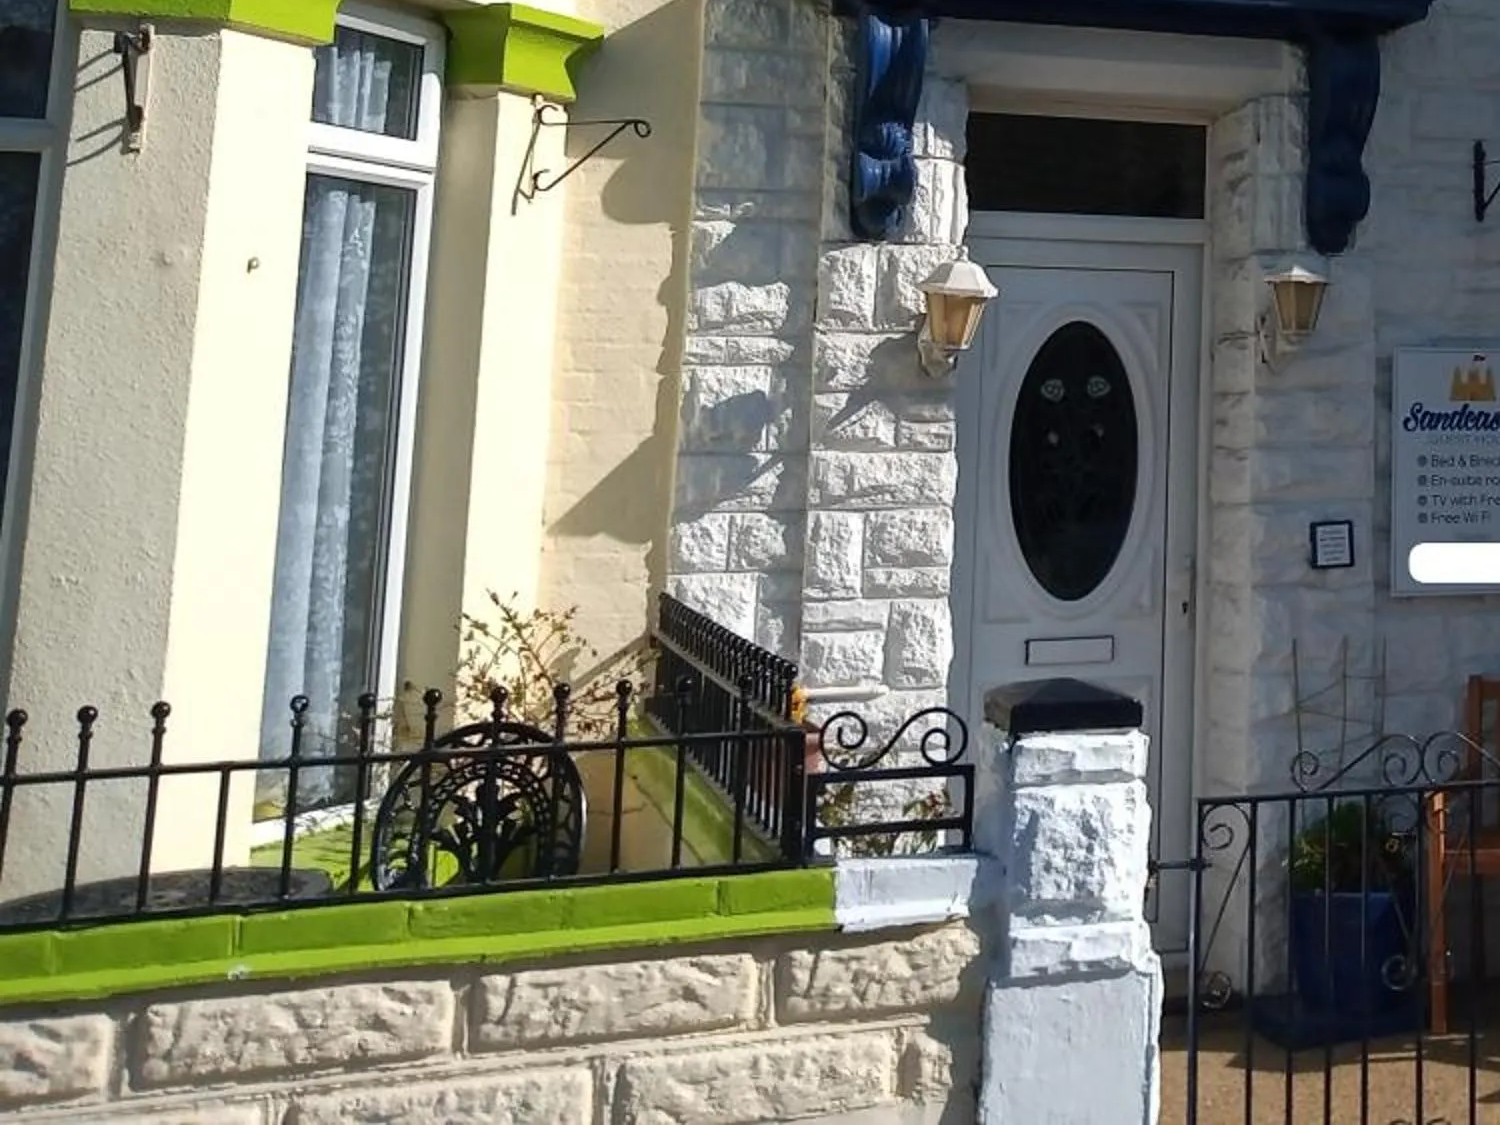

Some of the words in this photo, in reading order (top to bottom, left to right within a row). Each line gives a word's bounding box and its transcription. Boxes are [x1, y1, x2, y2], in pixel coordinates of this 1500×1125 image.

[1431, 454, 1455, 467] Bed
[1457, 455, 1467, 467] &
[1431, 475, 1482, 487] En-suite
[1431, 495, 1447, 506] TV
[1450, 495, 1477, 506] with
[1431, 513, 1461, 524] Free
[1463, 512, 1479, 523] Wi
